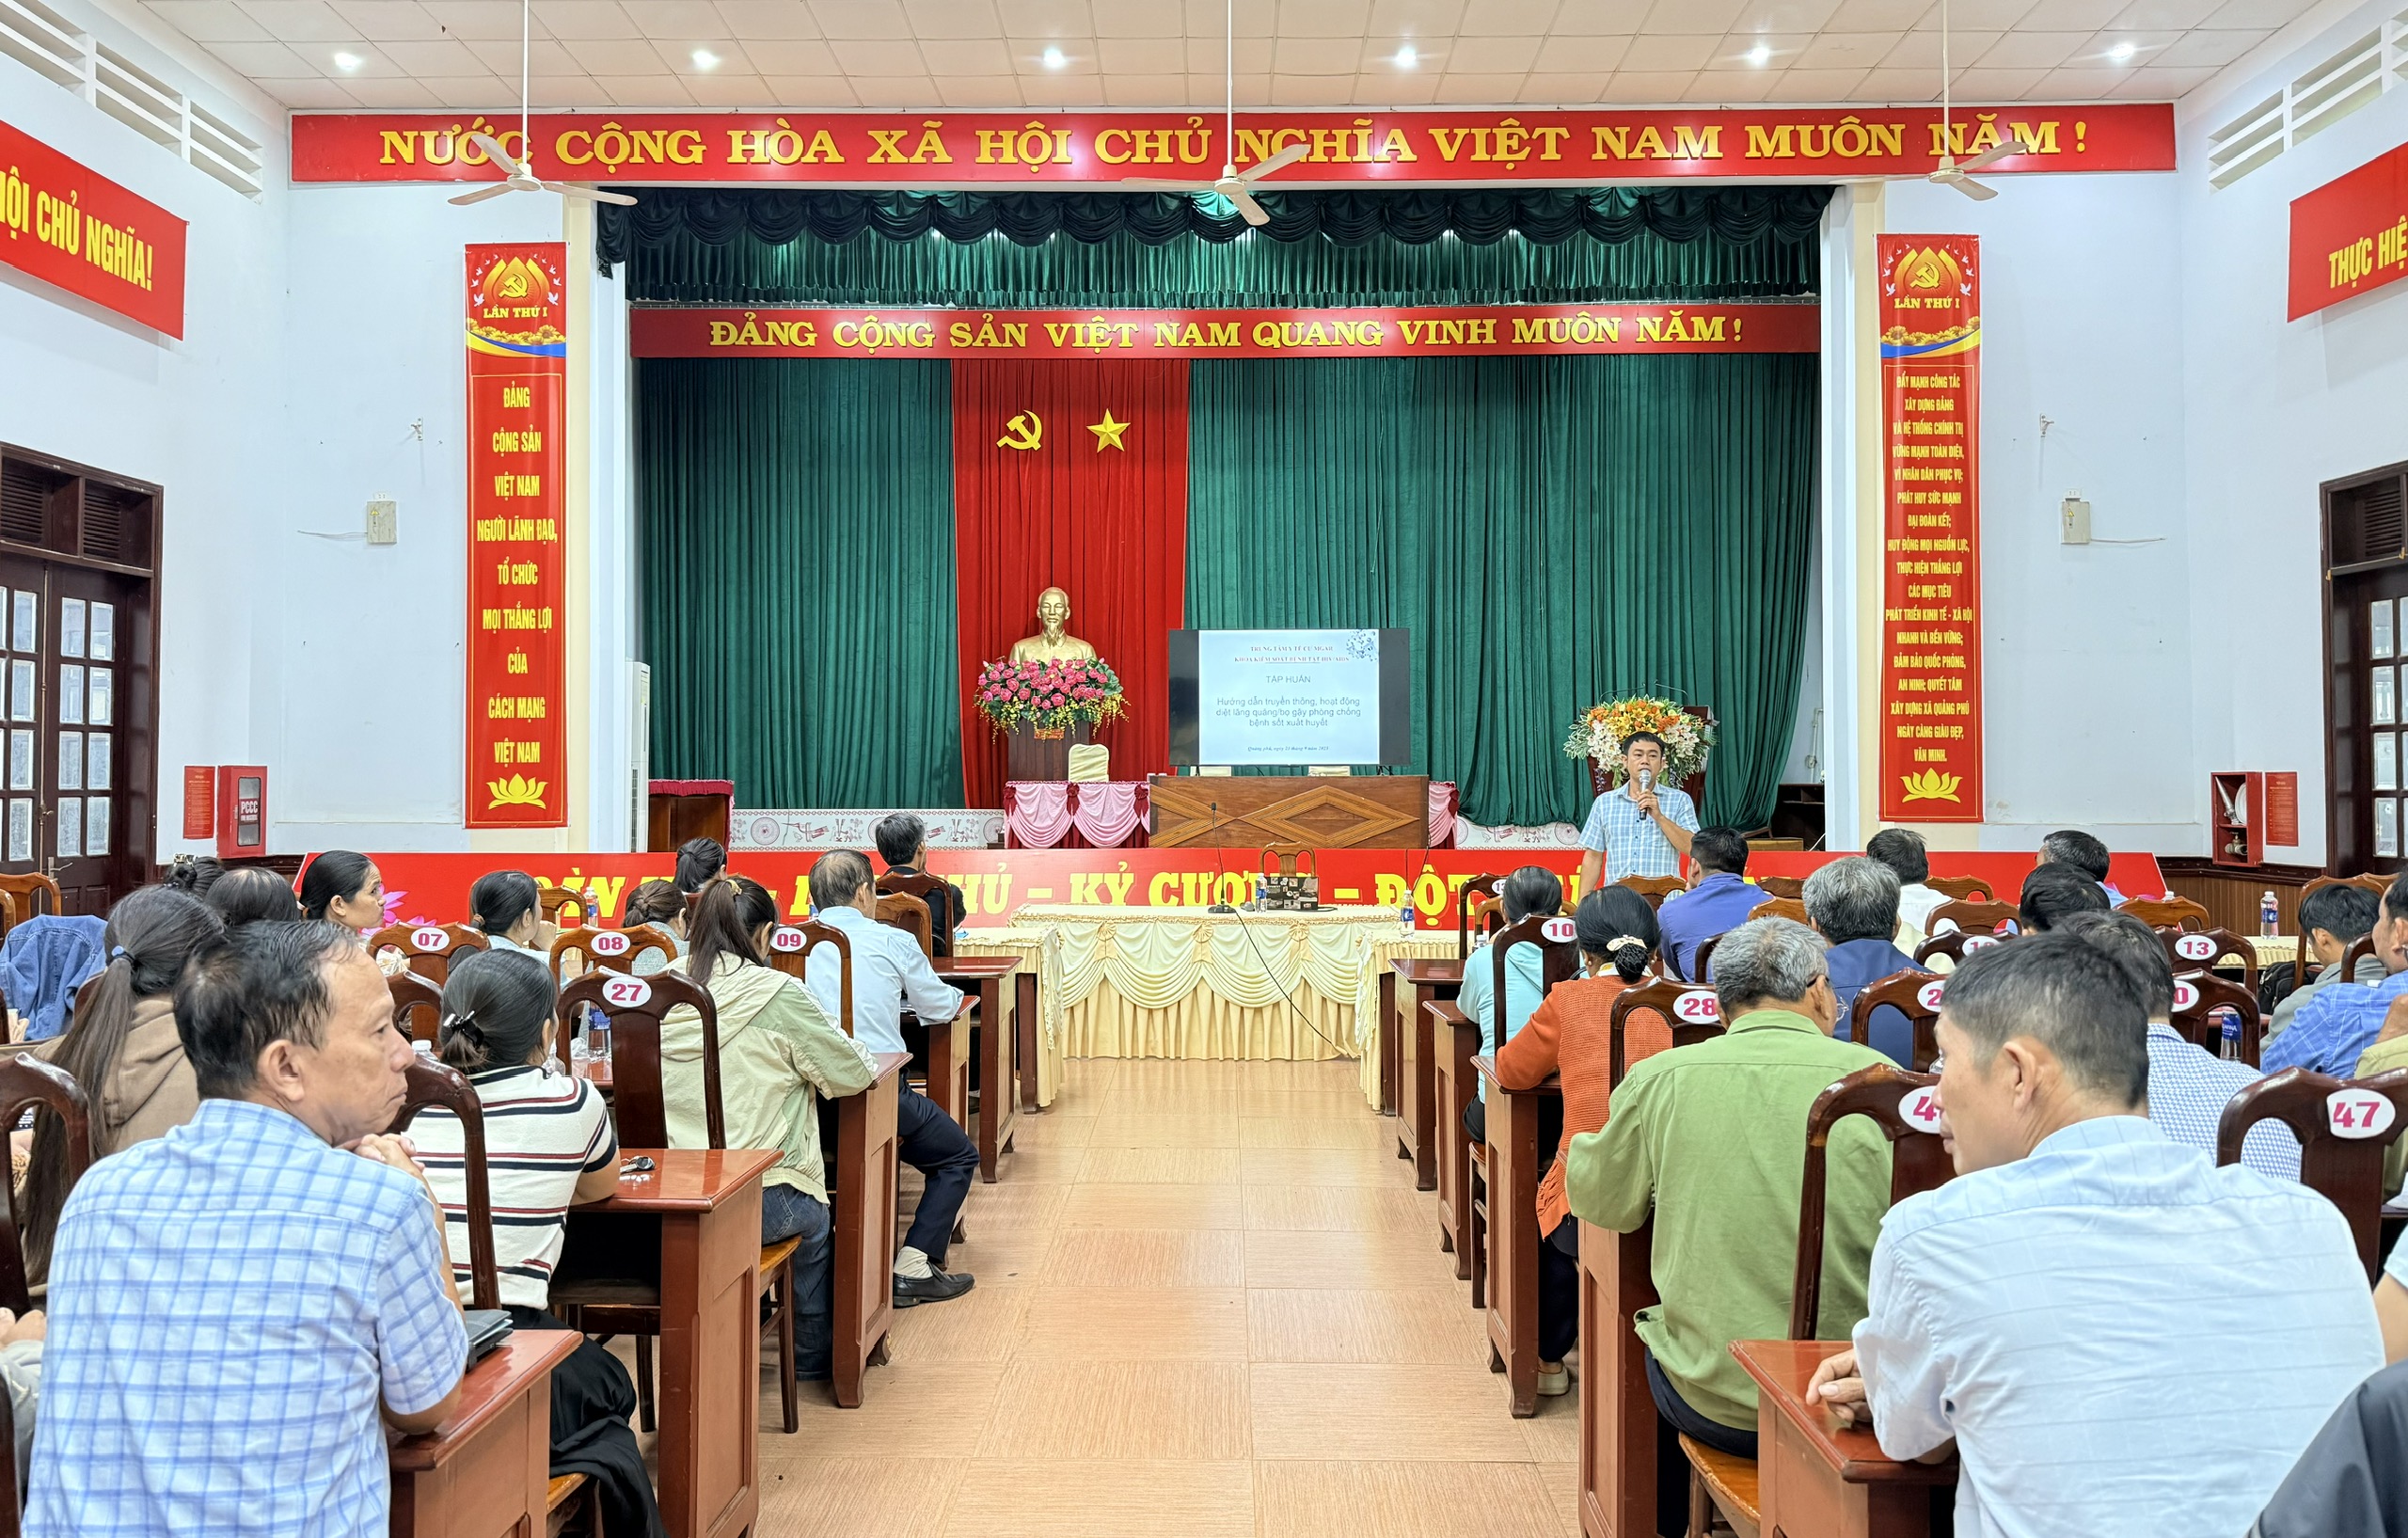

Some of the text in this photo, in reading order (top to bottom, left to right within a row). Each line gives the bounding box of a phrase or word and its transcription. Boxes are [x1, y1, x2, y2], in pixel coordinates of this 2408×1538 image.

[379, 113, 2062, 174] NƯỚC CỘNG HÒA XÃ HỘI CHỦ NGHĨA VIỆT NAM MUÔN NĂM
[36, 189, 80, 256] CHỦ
[86, 214, 153, 292] NGHĨA!
[2328, 237, 2373, 289] THỰC
[1893, 294, 1921, 309] LẦN
[1924, 295, 1953, 309] THỨ
[483, 305, 510, 319] LẦN
[512, 305, 541, 318] THỨ
[710, 311, 818, 347] ĐẢNG
[832, 315, 936, 355] CỘNG
[949, 312, 1029, 348] SẢN
[1043, 315, 1138, 354] VIỆT
[1153, 322, 1242, 347] NAM
[1252, 320, 1385, 349] QUANG
[1396, 318, 1497, 345] VINH
[1512, 310, 1621, 344] MUÔN
[1910, 375, 1929, 390] MẠNH
[1930, 373, 1948, 388] CÔNG
[1949, 373, 1961, 388] TÁC
[503, 381, 531, 408] ĐẢNG
[1904, 395, 1955, 414] XÂY DỰNG ĐẢNG
[1893, 420, 1902, 436] VÀ
[1903, 420, 1911, 437] HỆ
[1912, 418, 1933, 436] THỐNG
[1934, 420, 1955, 436] CHÍNH
[492, 424, 542, 457] CỘNG SẢN
[1893, 443, 1910, 459] VỮNG
[1910, 445, 1930, 461] MẠNH
[1930, 443, 1948, 458] TOÀN
[1893, 466, 1964, 484] VÌ NHÂN DÂN PHỤC VỤ;
[494, 471, 540, 500] VIỆT NAM
[1896, 489, 1962, 507] PHÁT HUY SỨC MẠNH
[476, 515, 558, 545] NGƯỜI LÃNH ĐẠO,
[1908, 511, 1952, 530] ĐẠI ĐOÀN KẾT;
[1887, 533, 1971, 554] HUY ĐỘNG MỌI NGUỒN LỰC,
[497, 556, 538, 585] TỔ CHỨC
[1895, 561, 1913, 577] THỰC
[1913, 560, 1929, 577] HIỆN
[1929, 559, 1952, 575] THẮNG
[1908, 582, 1952, 601] CÁC MỤC TIÊU
[483, 601, 552, 633] MỌI THẮNG LỢI
[1885, 604, 1972, 624] PHÁT TRIỂN KINH TẾ XÃ HỘI
[1896, 627, 1964, 646] NHANH VÀ BỀN VỮNG;
[507, 646, 529, 674] CỦA
[1893, 651, 1967, 670] ĐẢM BẢO QUỐC PHÒNG,
[1285, 674, 1311, 684] HUẤN
[1897, 674, 1963, 692] AN NINH; QUYẾT TÂM
[487, 693, 546, 722] CÁCH MẠNG
[1217, 695, 1360, 707] Hướng dẫn truyền thông, hoạt động
[1890, 699, 1970, 718] XÂY DỰNG XÃ QUẢNG PHÚ
[1215, 708, 1231, 718] diệt
[1291, 708, 1307, 718] gậy
[1308, 708, 1335, 718] phòng
[1336, 706, 1361, 718] chống
[1249, 717, 1328, 728] bệnh sốt xuất huyết
[1896, 723, 1964, 741] NGÀY CÀNG GIÀU ĐẸP,
[494, 737, 541, 768] VIỆT NAM
[1913, 746, 1948, 762] VĂN MINH.
[240, 801, 259, 815] PCCC
[1069, 862, 1134, 906] KỶ
[1549, 923, 1574, 937] 10
[418, 933, 443, 947] 07
[598, 937, 624, 950] 08
[777, 933, 801, 947] 09
[2183, 941, 2210, 956] 13
[611, 983, 643, 1002] 27
[1683, 997, 1717, 1016] 28
[2333, 1102, 2381, 1128] 47
